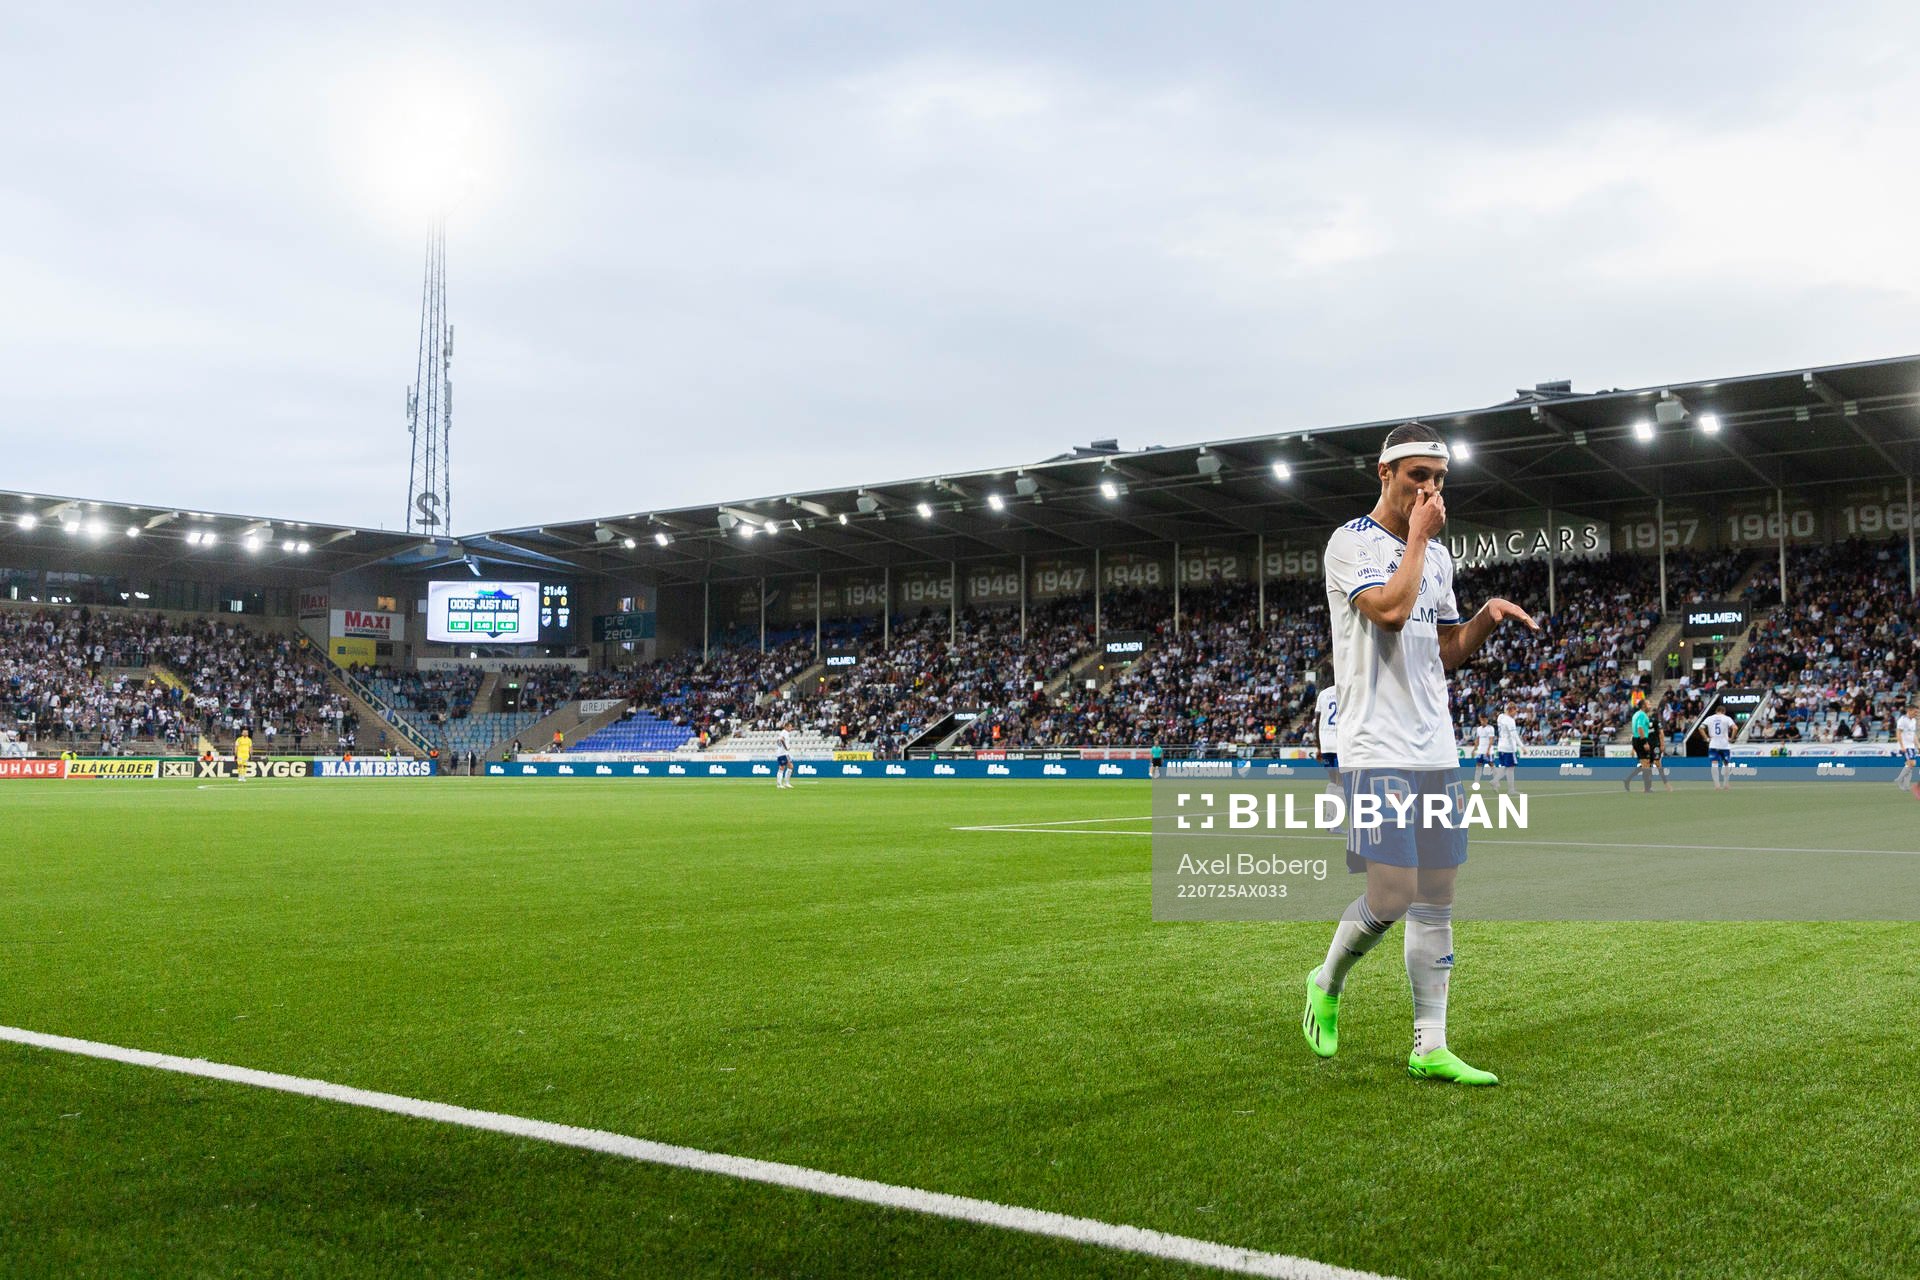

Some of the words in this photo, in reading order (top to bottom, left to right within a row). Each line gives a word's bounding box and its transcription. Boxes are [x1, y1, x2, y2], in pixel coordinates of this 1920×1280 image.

[1621, 519, 1699, 549] 1957
[1727, 511, 1815, 542] 1960
[1256, 549, 1318, 575] 956
[1035, 567, 1087, 592] 1947
[1103, 561, 1160, 586] 1948
[902, 578, 952, 601] 1945
[968, 573, 1019, 597] 1946
[450, 599, 475, 610] ODDS
[476, 599, 500, 610] JUST
[501, 599, 518, 610] NU!
[344, 610, 391, 629] MAXI
[604, 615, 625, 629] pre
[1689, 612, 1742, 625] HOLMEN
[604, 628, 633, 640] zero
[1106, 641, 1142, 653] HOLMEN
[827, 655, 856, 666] HOLMEN
[1722, 695, 1760, 704] HOLMEN
[1328, 701, 1337, 726] 2
[1529, 749, 1578, 757] XPANDERA
[70, 760, 153, 774] BLÅKLÄDER
[321, 761, 431, 777] MALMBERGS
[1165, 761, 1233, 777] ALLSVENSKAN
